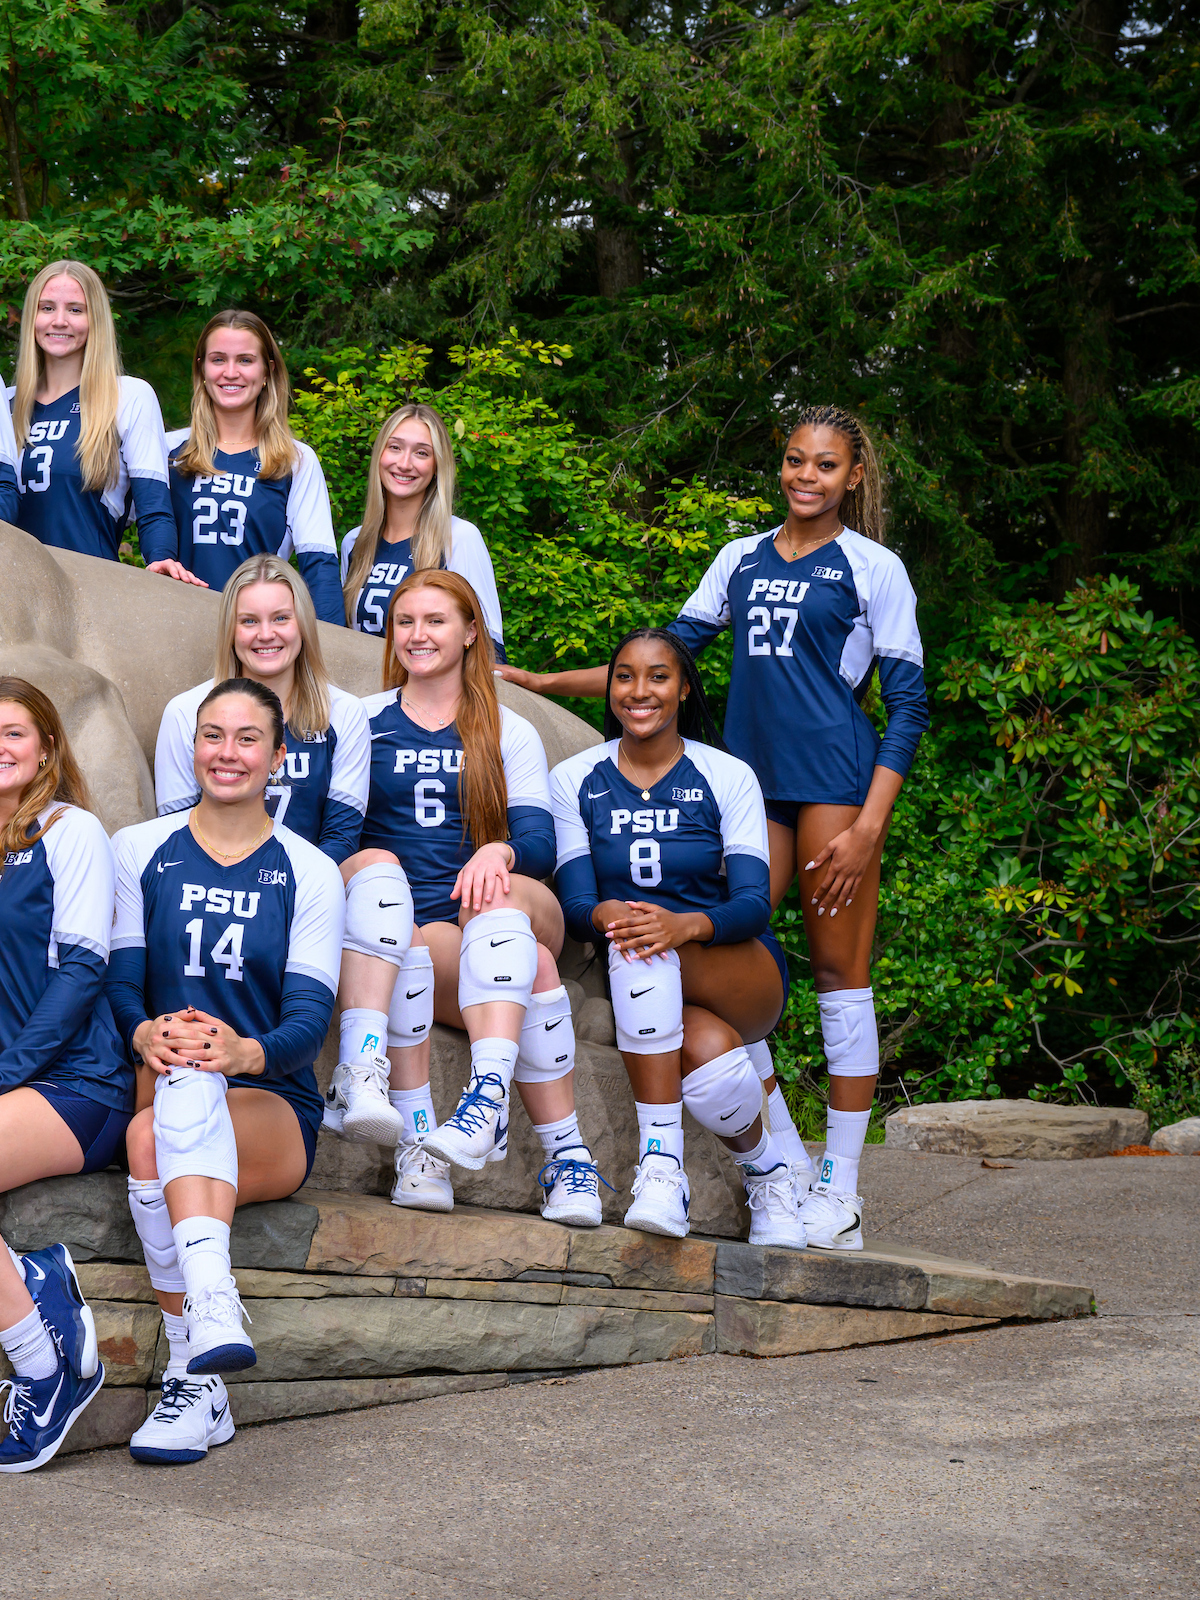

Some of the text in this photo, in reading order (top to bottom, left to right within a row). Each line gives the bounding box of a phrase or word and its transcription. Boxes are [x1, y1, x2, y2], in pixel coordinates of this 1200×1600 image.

[28, 420, 70, 443] SU
[192, 473, 256, 498] PSU
[192, 497, 247, 546] 23
[367, 563, 409, 586] SU
[747, 578, 810, 604] PSU
[747, 606, 799, 657] 27
[393, 749, 467, 773] PSU
[414, 778, 446, 828] 6
[610, 808, 680, 835] PSU
[629, 837, 663, 888] 8
[179, 883, 261, 919] PSU
[184, 918, 245, 982] 14
